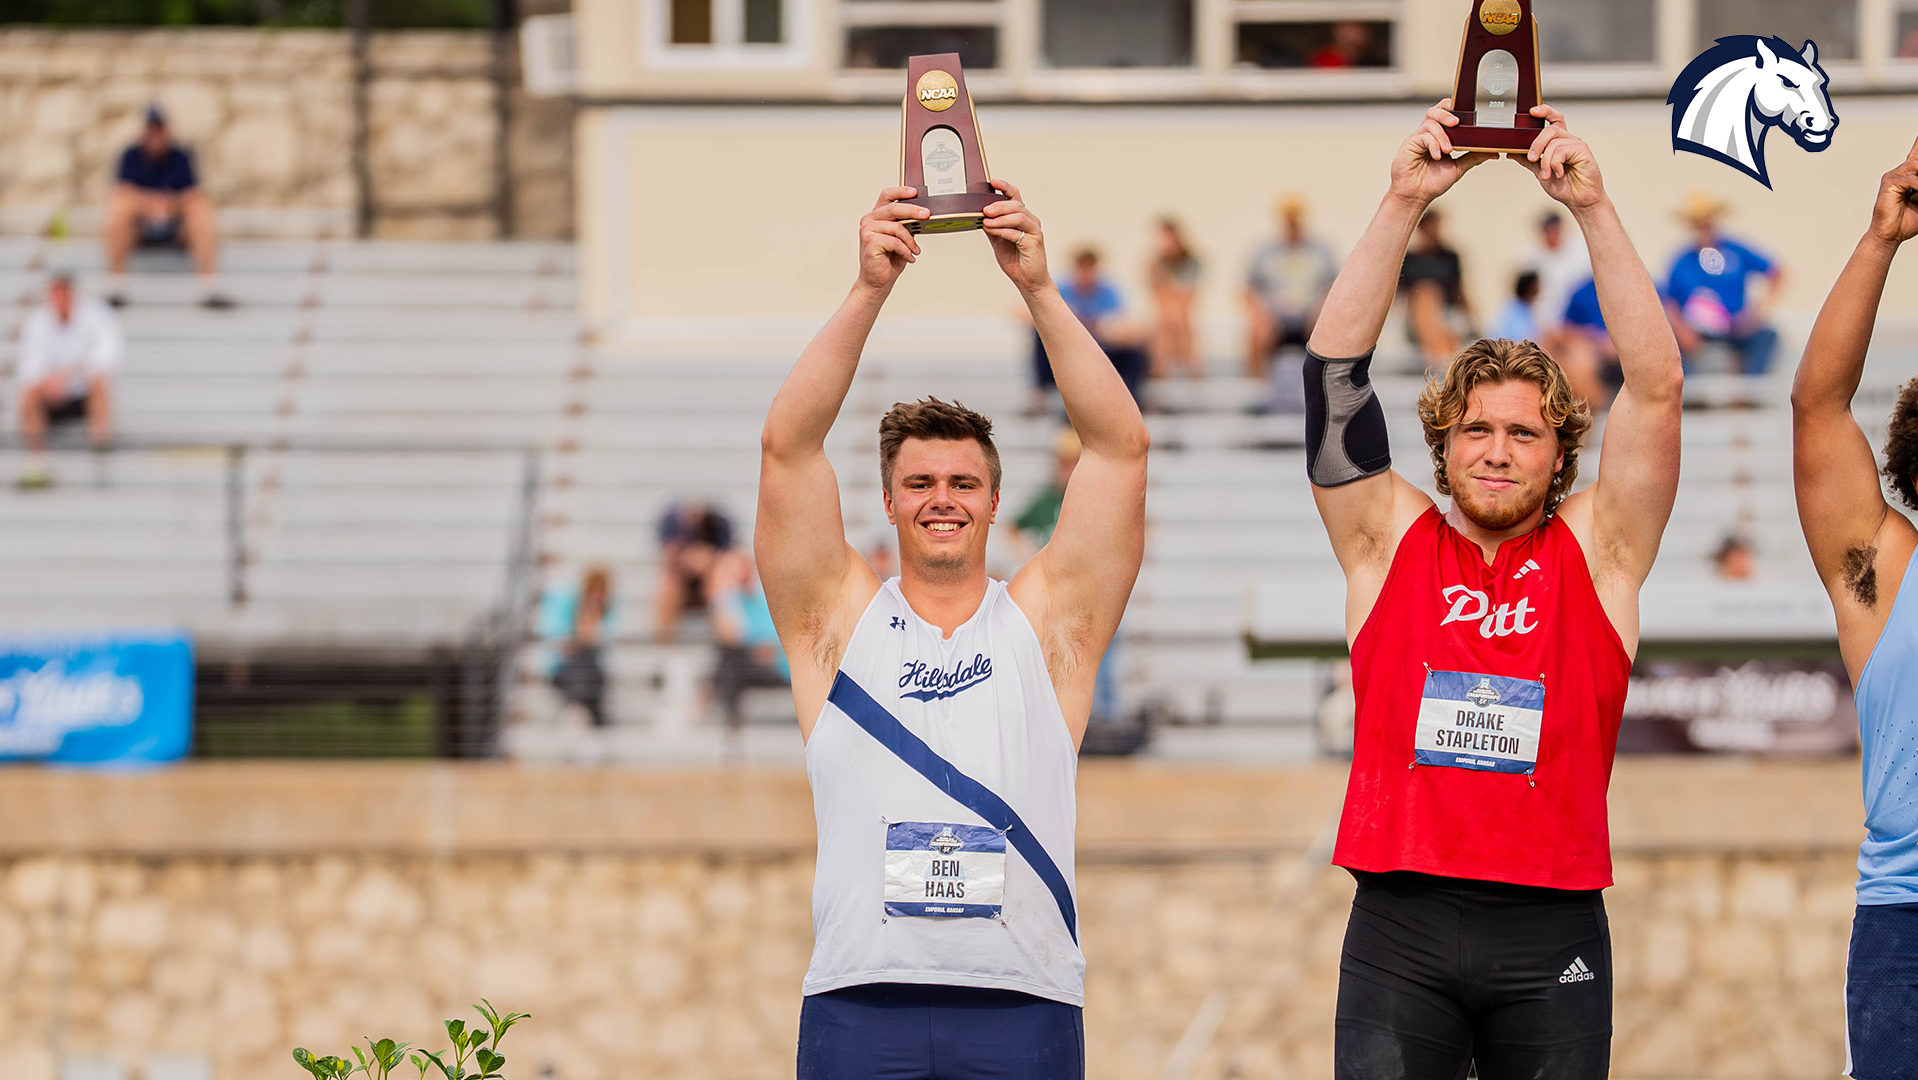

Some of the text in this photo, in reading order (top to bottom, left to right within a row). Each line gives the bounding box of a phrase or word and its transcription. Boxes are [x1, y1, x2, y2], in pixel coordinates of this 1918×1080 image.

[1482, 11, 1519, 25] NCAA
[920, 87, 956, 101] NCAA
[1440, 584, 1539, 639] Pitt
[898, 653, 993, 690] Hillsdale
[1456, 709, 1505, 731] DRAKE
[1435, 729, 1520, 755] STAPLETON
[1477, 759, 1496, 767] KANSAS
[932, 860, 960, 877] BEN
[925, 881, 965, 898] HAAS
[1559, 971, 1595, 984] adidas
